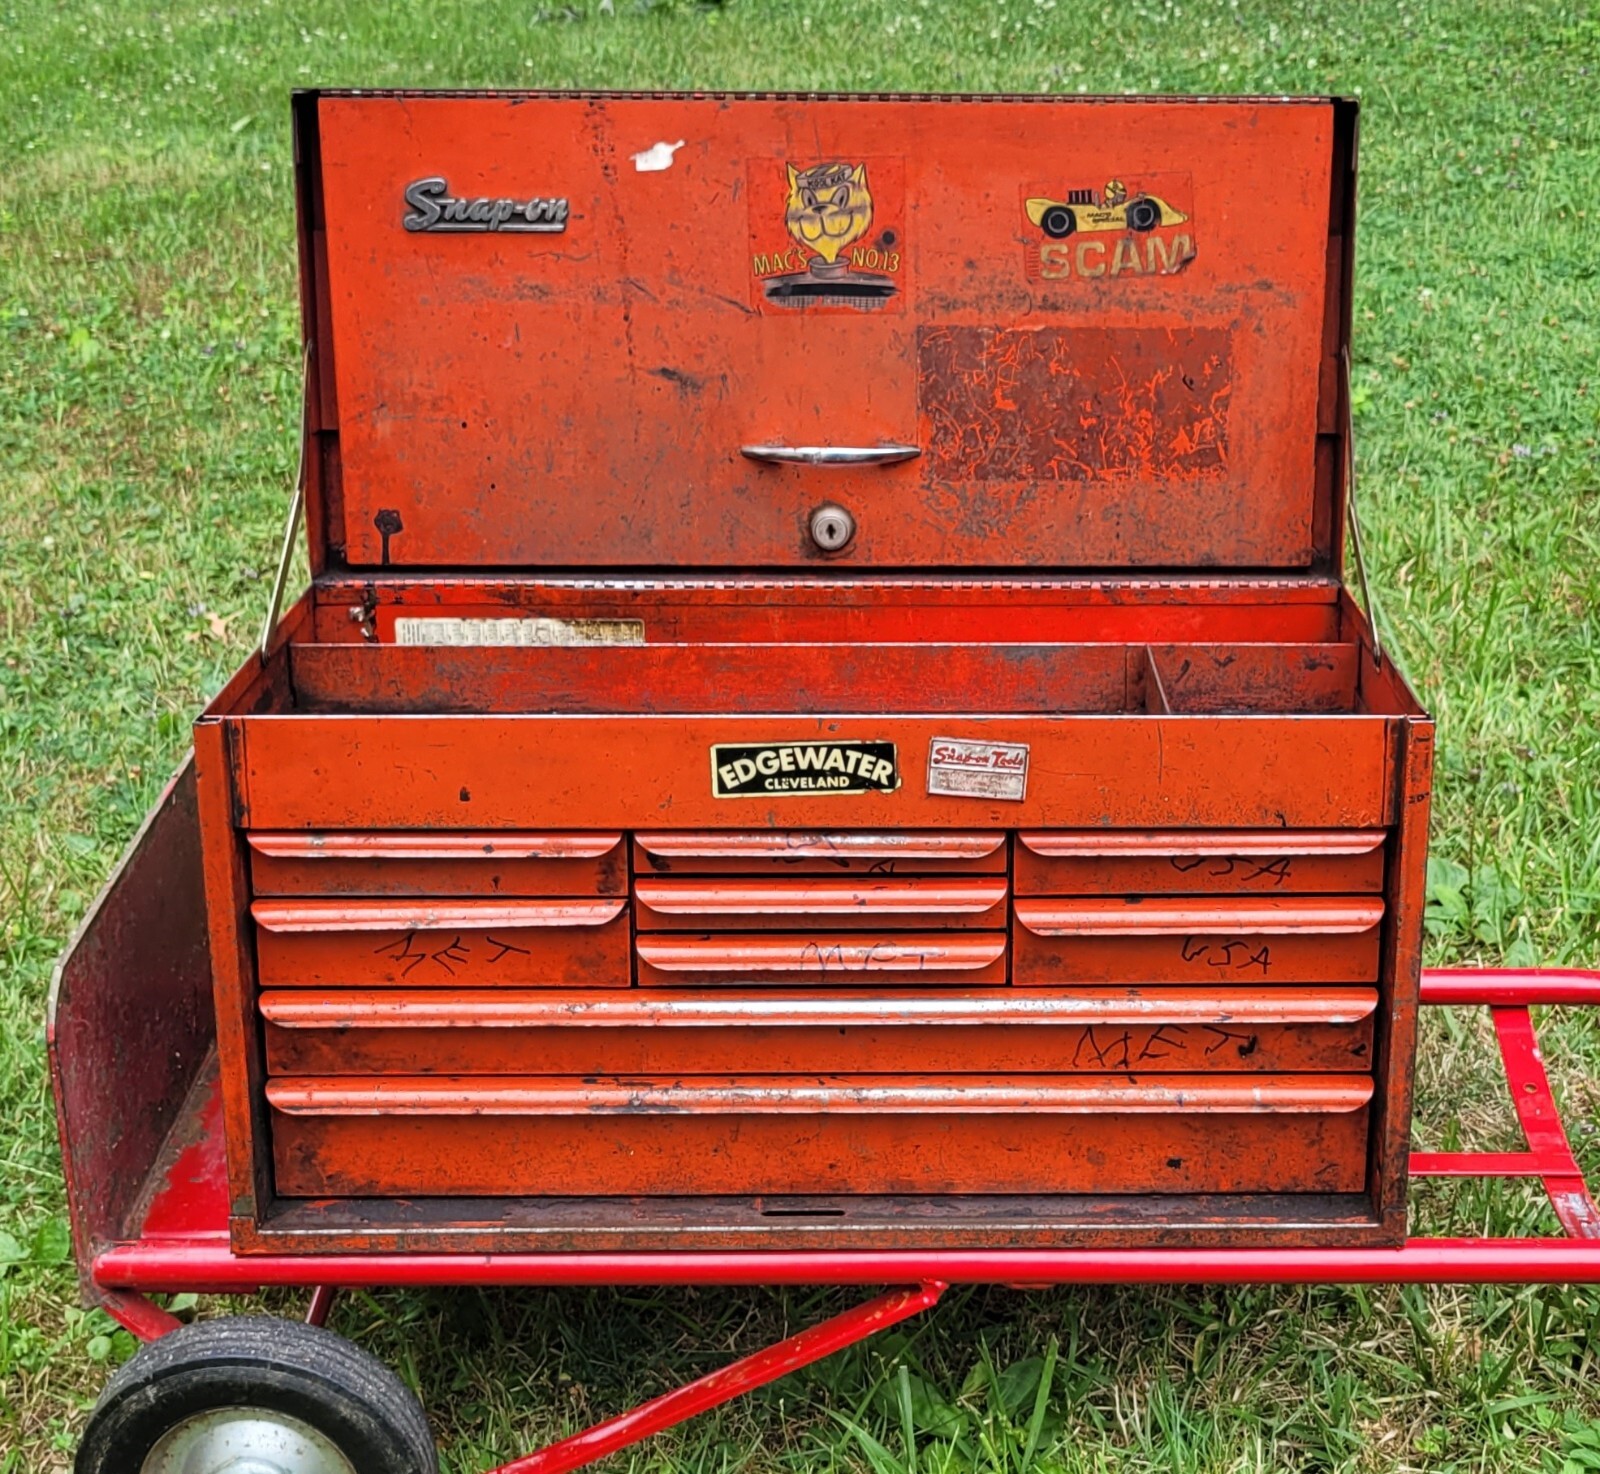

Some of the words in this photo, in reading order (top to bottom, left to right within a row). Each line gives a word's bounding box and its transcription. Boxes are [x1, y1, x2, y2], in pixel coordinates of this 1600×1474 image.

[404, 176, 568, 232] Snap-on
[753, 248, 808, 277] MAC'S
[1040, 235, 1192, 280] SCAM
[718, 746, 894, 791] EDGEWATER
[933, 746, 989, 767] Snap-on
[991, 750, 1024, 770] Tools
[764, 776, 850, 790] CLEVELAND
